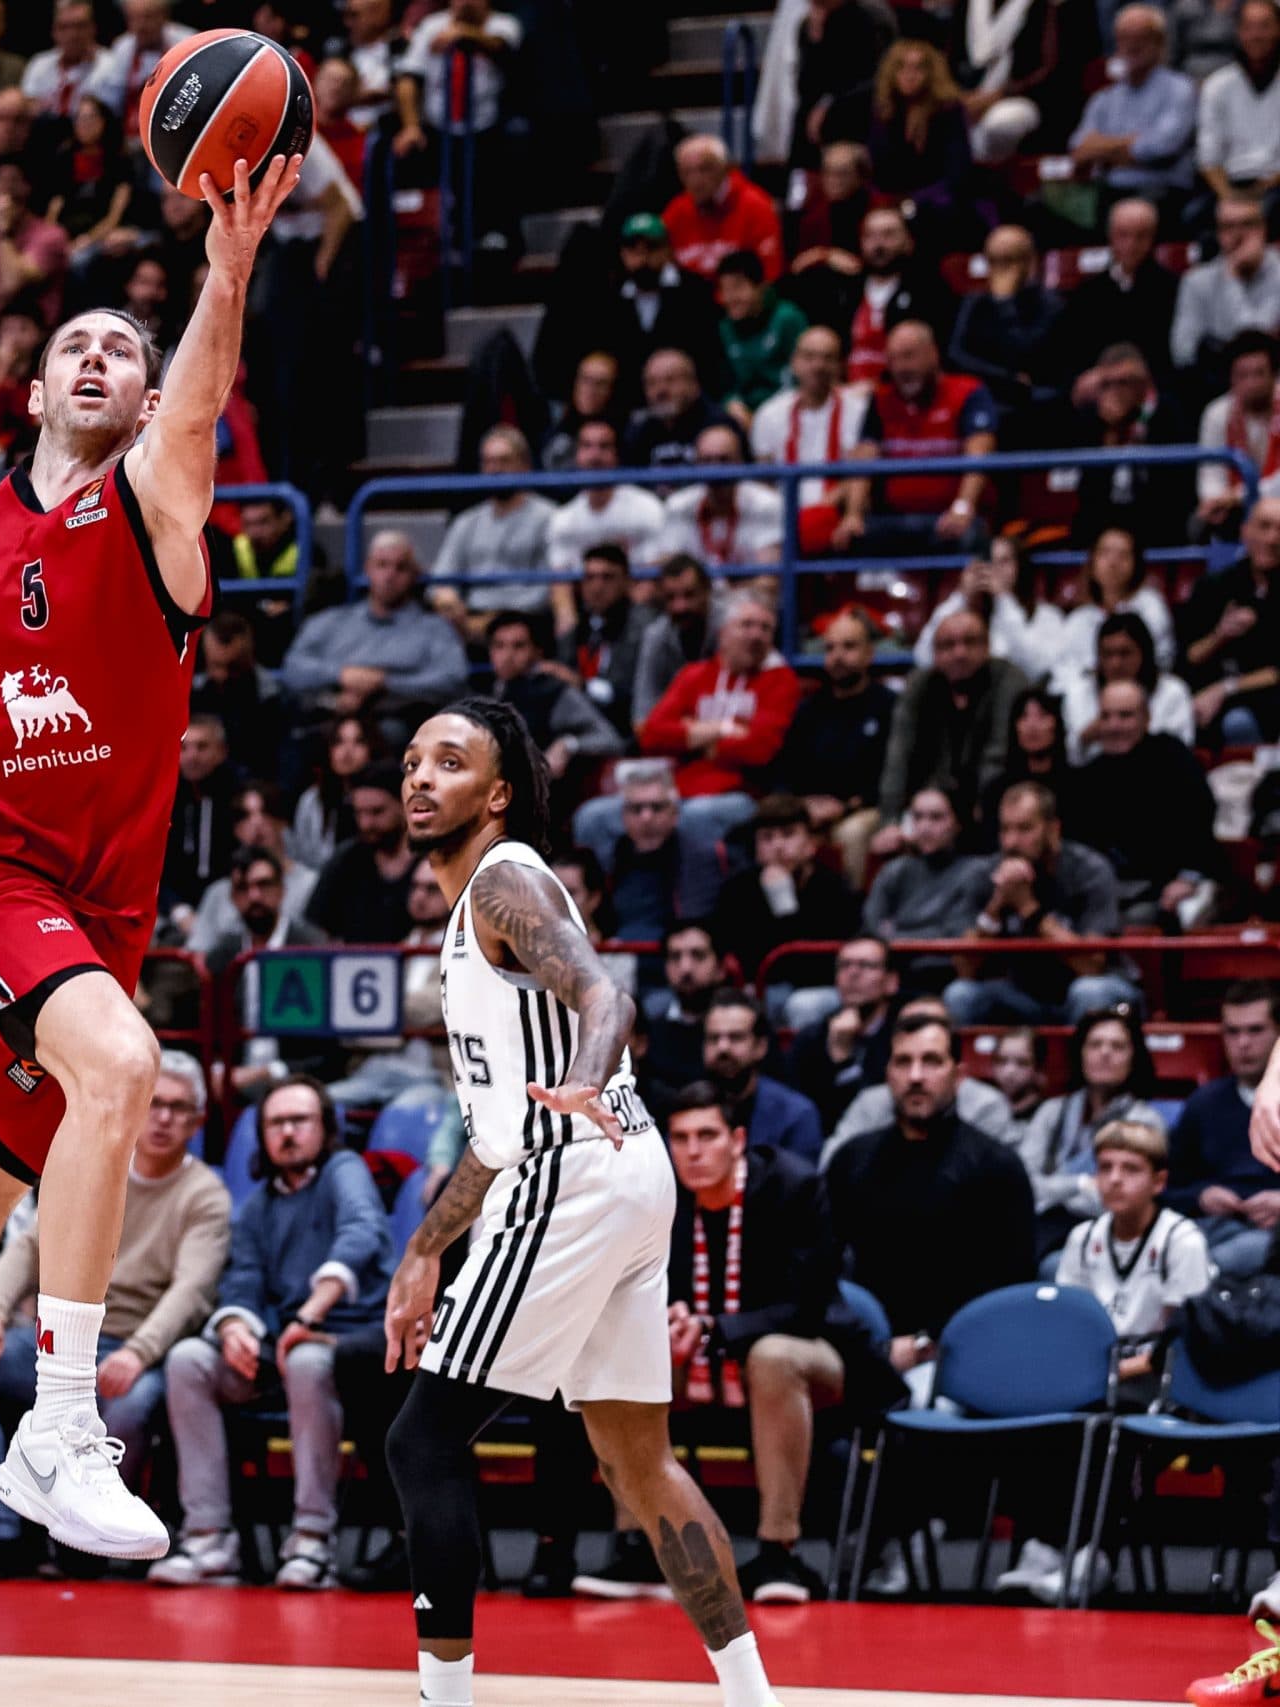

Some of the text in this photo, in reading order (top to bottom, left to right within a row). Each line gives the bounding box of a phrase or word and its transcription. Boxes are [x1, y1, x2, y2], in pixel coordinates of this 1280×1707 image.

[21, 558, 49, 631] 5
[2, 744, 112, 777] plenitude
[274, 968, 380, 1016] A 6
